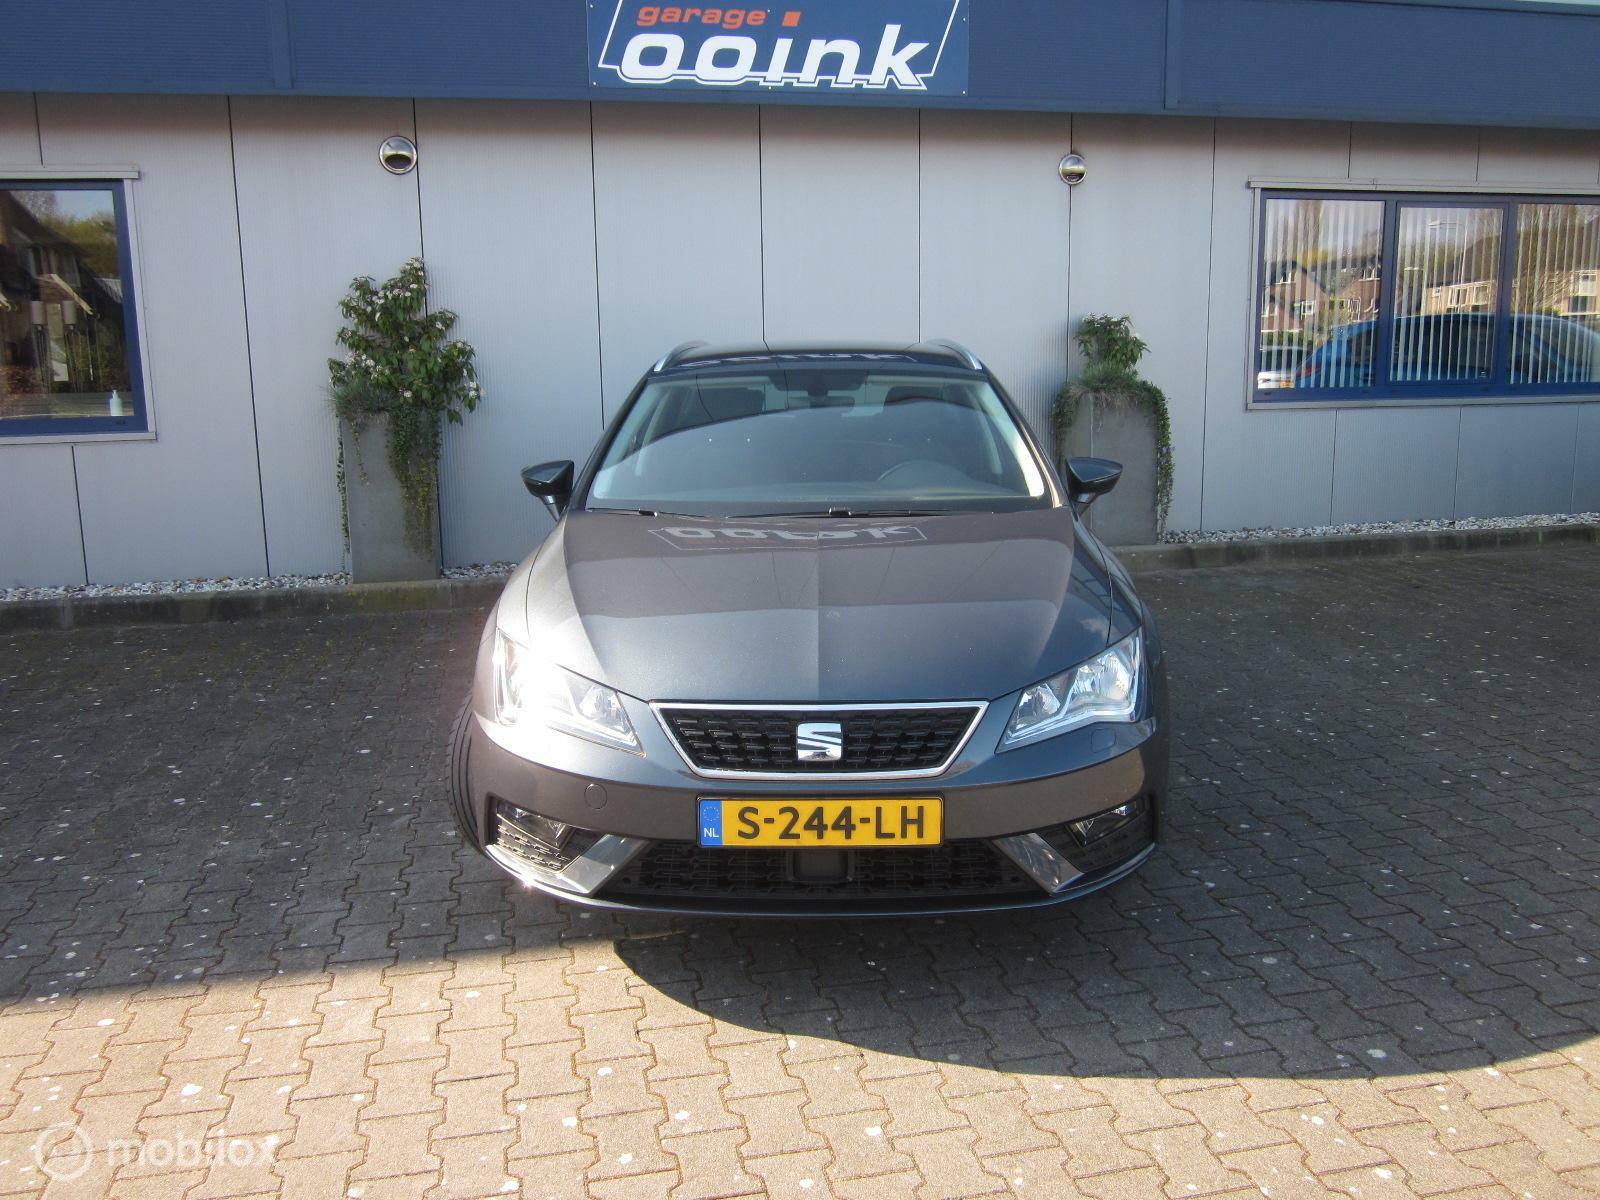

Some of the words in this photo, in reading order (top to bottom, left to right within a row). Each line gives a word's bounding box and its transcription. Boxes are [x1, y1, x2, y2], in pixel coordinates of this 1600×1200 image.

[636, 6, 767, 29] garage
[621, 12, 930, 86] ooink
[703, 827, 720, 838] NL
[737, 805, 924, 840] S-244-LH
